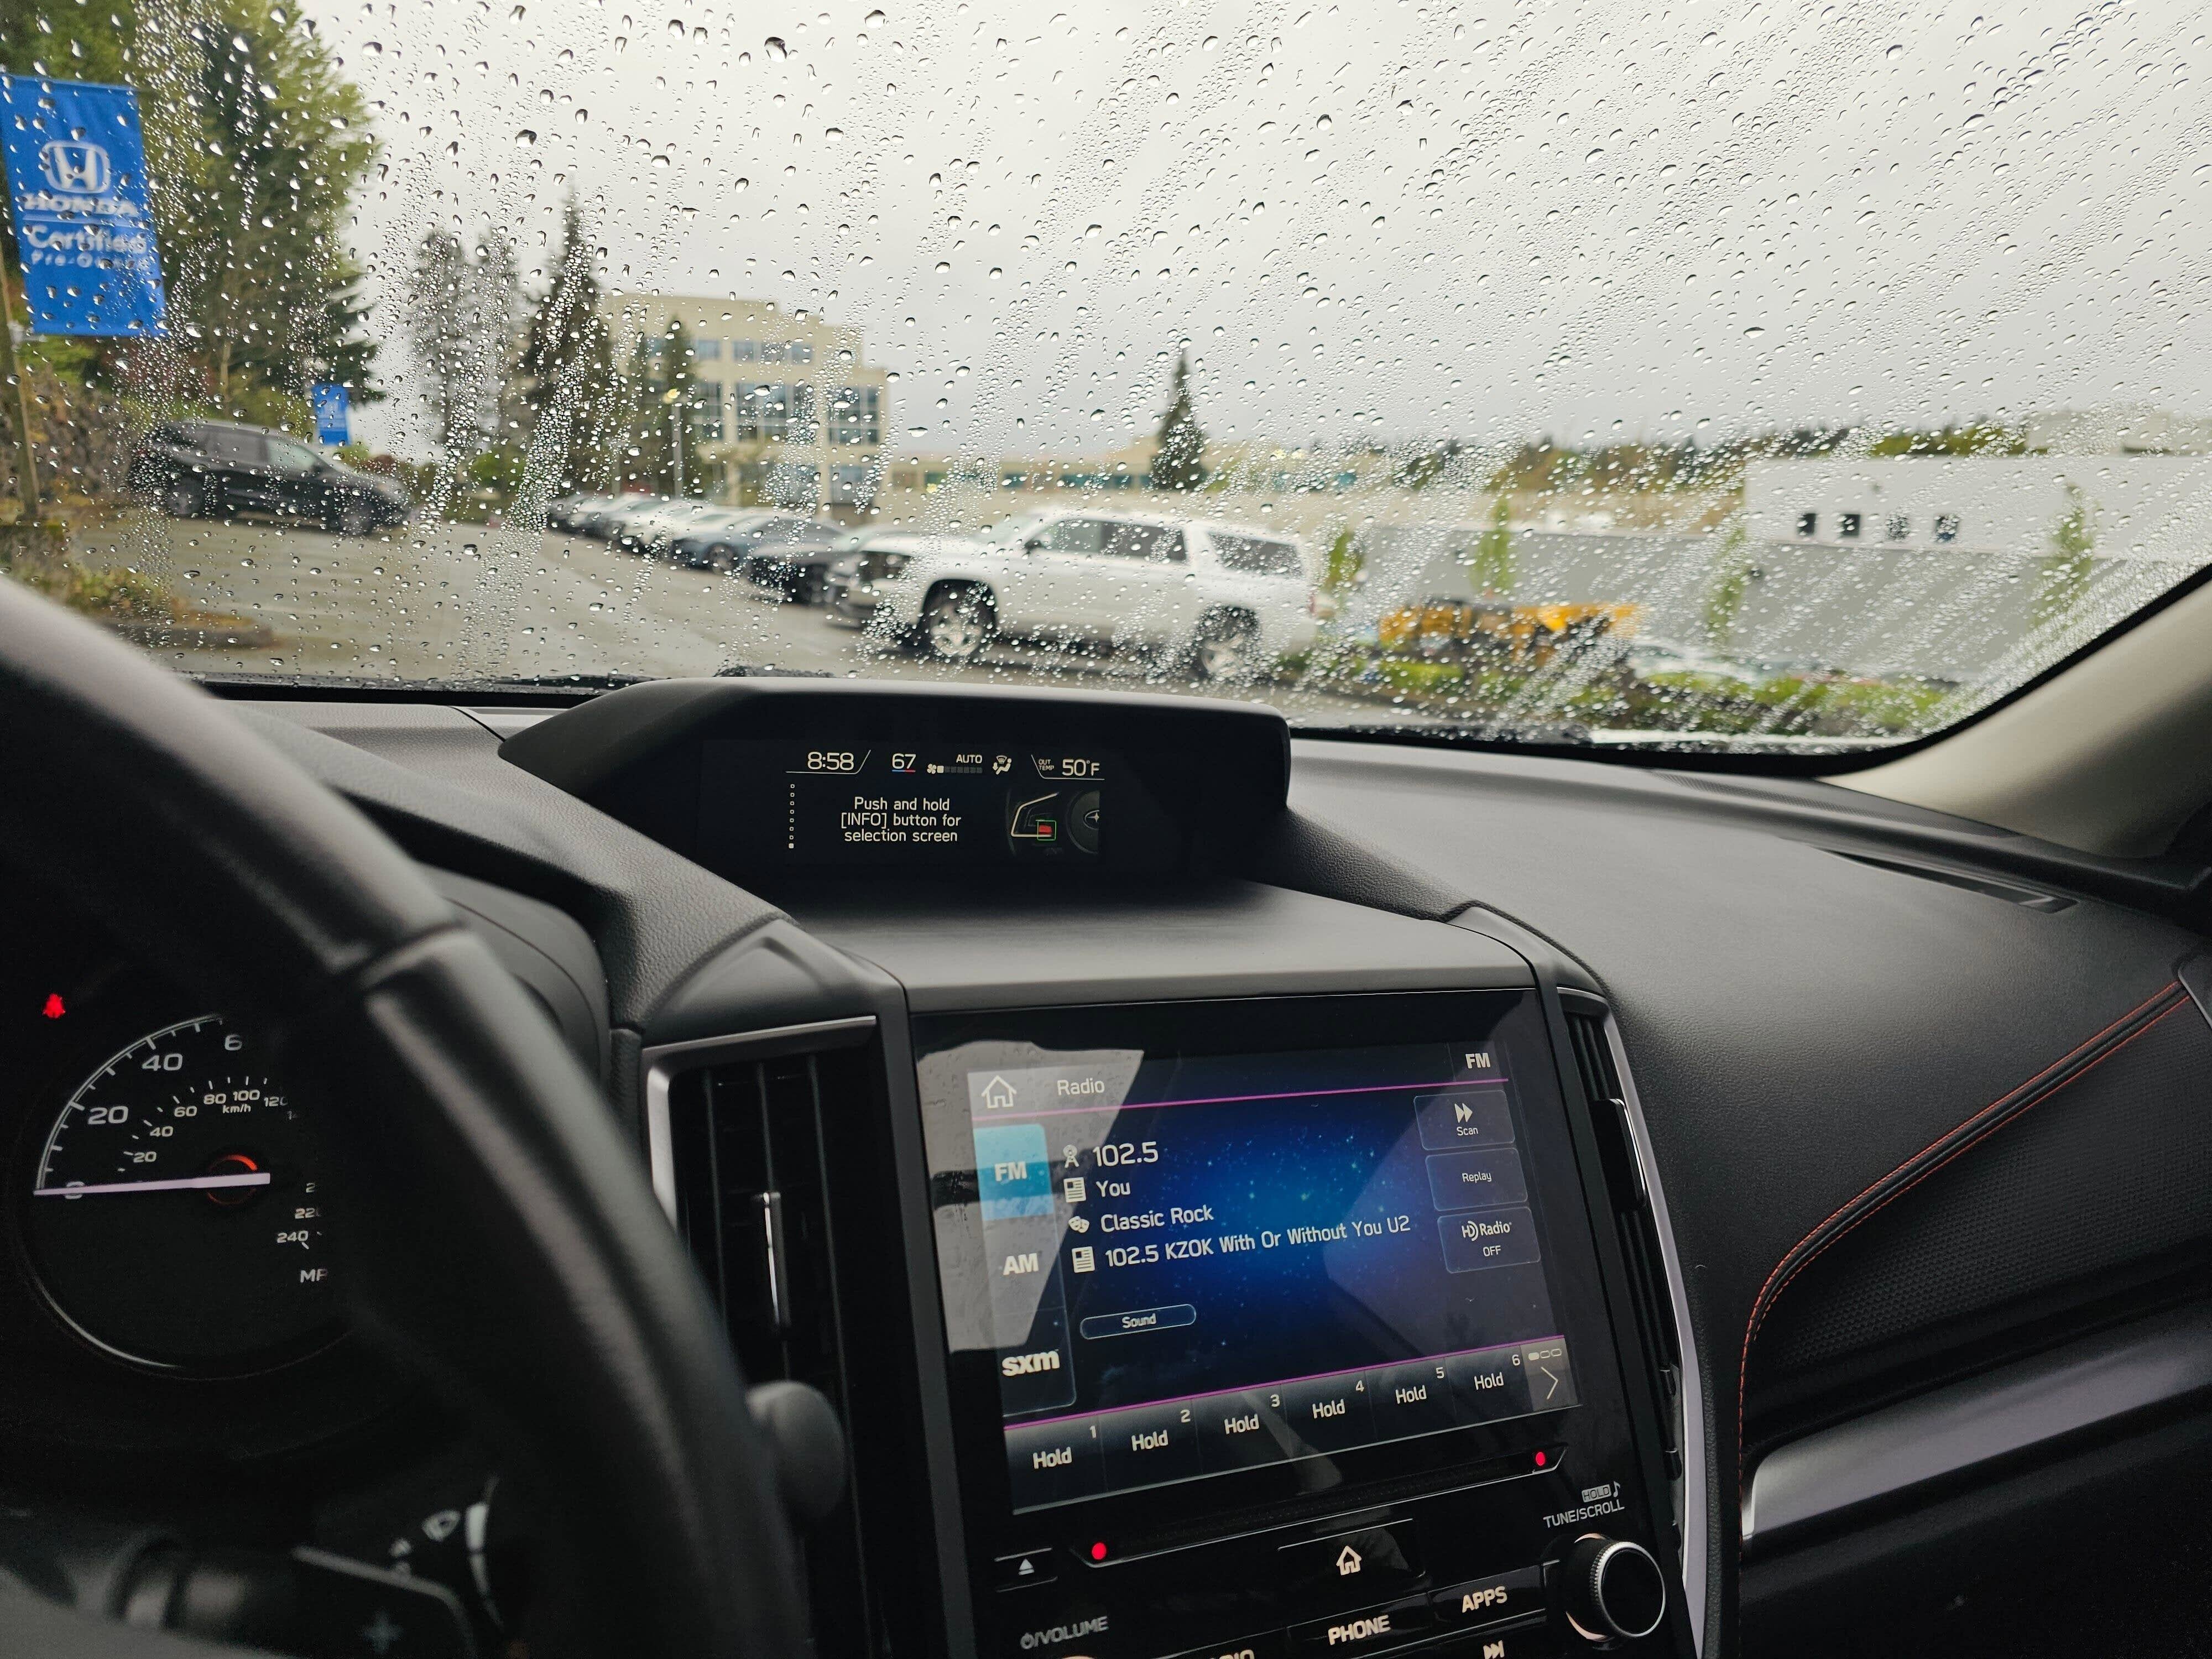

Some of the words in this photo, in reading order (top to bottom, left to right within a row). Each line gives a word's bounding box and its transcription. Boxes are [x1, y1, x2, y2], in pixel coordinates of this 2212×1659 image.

[23, 194, 138, 216] HONDA
[807, 752, 854, 771] 8:58
[892, 753, 916, 769] 67
[956, 754, 983, 764] AUTO
[854, 796, 888, 810] Push
[893, 797, 917, 811] and
[923, 797, 950, 811] hold
[841, 812, 887, 828] [INFO]
[893, 813, 937, 827] button
[942, 813, 962, 827] for
[844, 828, 906, 842] selection
[912, 832, 957, 842] screen
[224, 1034, 242, 1051] 6
[142, 1053, 183, 1071] 40
[1465, 1052, 1491, 1069] FM
[1057, 1077, 1105, 1095] Radio
[203, 1093, 227, 1105] 80
[233, 1089, 260, 1101] 100
[88, 1105, 129, 1125] 20
[174, 1105, 197, 1117] 60
[222, 1103, 251, 1114] km/h
[149, 1124, 174, 1137] 40
[1456, 1126, 1479, 1136] Scan
[133, 1151, 157, 1163] 20
[1093, 1141, 1159, 1167] 102.5
[995, 1162, 1027, 1181] FM
[1462, 1171, 1492, 1183] Replay
[1095, 1180, 1131, 1197] You
[295, 1208, 320, 1219] 22
[1100, 1210, 1165, 1233] Classic
[1170, 1204, 1214, 1224] Rock
[1479, 1219, 1510, 1237] Radio
[277, 1230, 309, 1243] 240
[1105, 1244, 1159, 1267] 102.5
[1165, 1238, 1214, 1260] KZOK
[1219, 1234, 1255, 1253] With
[1261, 1230, 1281, 1248] Or
[1286, 1223, 1348, 1245] Without
[1351, 1220, 1383, 1237] You
[1386, 1215, 1411, 1233] U2
[1483, 1245, 1501, 1257] OFF
[1003, 1253, 1039, 1276] AM
[300, 1269, 328, 1283] MP
[1121, 1313, 1156, 1328] Sound
[1001, 1350, 1060, 1376] sxm
[1512, 1354, 1521, 1366] 6
[1436, 1366, 1444, 1379] 5
[1474, 1371, 1504, 1390] Hold
[1355, 1380, 1364, 1392] 4
[1270, 1394, 1280, 1407] 3
[1395, 1385, 1427, 1404] Hold
[1180, 1409, 1191, 1423] 2
[1312, 1399, 1345, 1419] Hold
[1089, 1425, 1097, 1438] 1
[1224, 1413, 1259, 1434] Hold
[1131, 1430, 1168, 1452] Hold
[1032, 1446, 1072, 1469] Hold
[1583, 1486, 1610, 1501] HOLD
[1543, 1497, 1625, 1528] TUNE/SCROLL
[1462, 1585, 1507, 1613] APPS
[1328, 1615, 1390, 1645] PHONE
